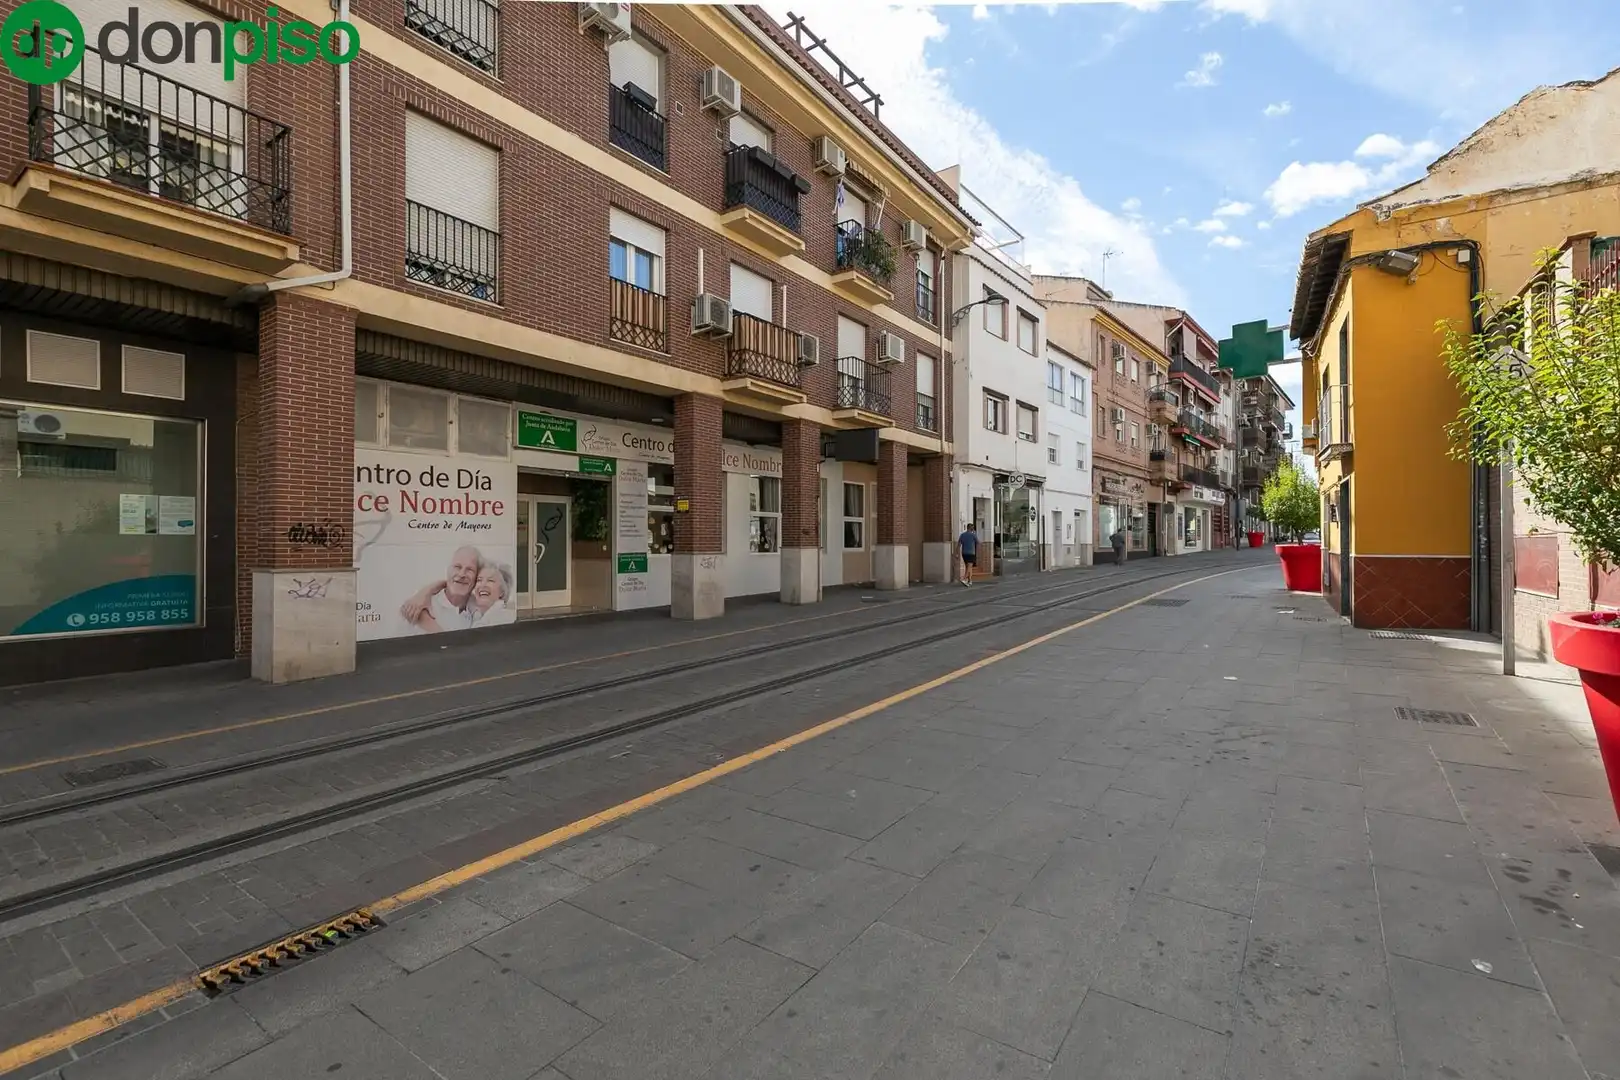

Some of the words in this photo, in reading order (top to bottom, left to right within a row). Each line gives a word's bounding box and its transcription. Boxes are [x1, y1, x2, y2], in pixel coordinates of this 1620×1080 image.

[622, 432, 665, 452] Centro
[356, 464, 411, 485] ntro
[419, 466, 450, 488] de
[457, 469, 492, 490] Día
[357, 494, 389, 512] ce
[399, 490, 504, 516] Nombre
[408, 519, 440, 529] Centro
[443, 519, 453, 529] de
[455, 520, 492, 532] Mayores
[150, 599, 188, 607] GRATUITA
[89, 612, 121, 625] 958
[126, 610, 156, 622] 958
[160, 608, 189, 620] 855
